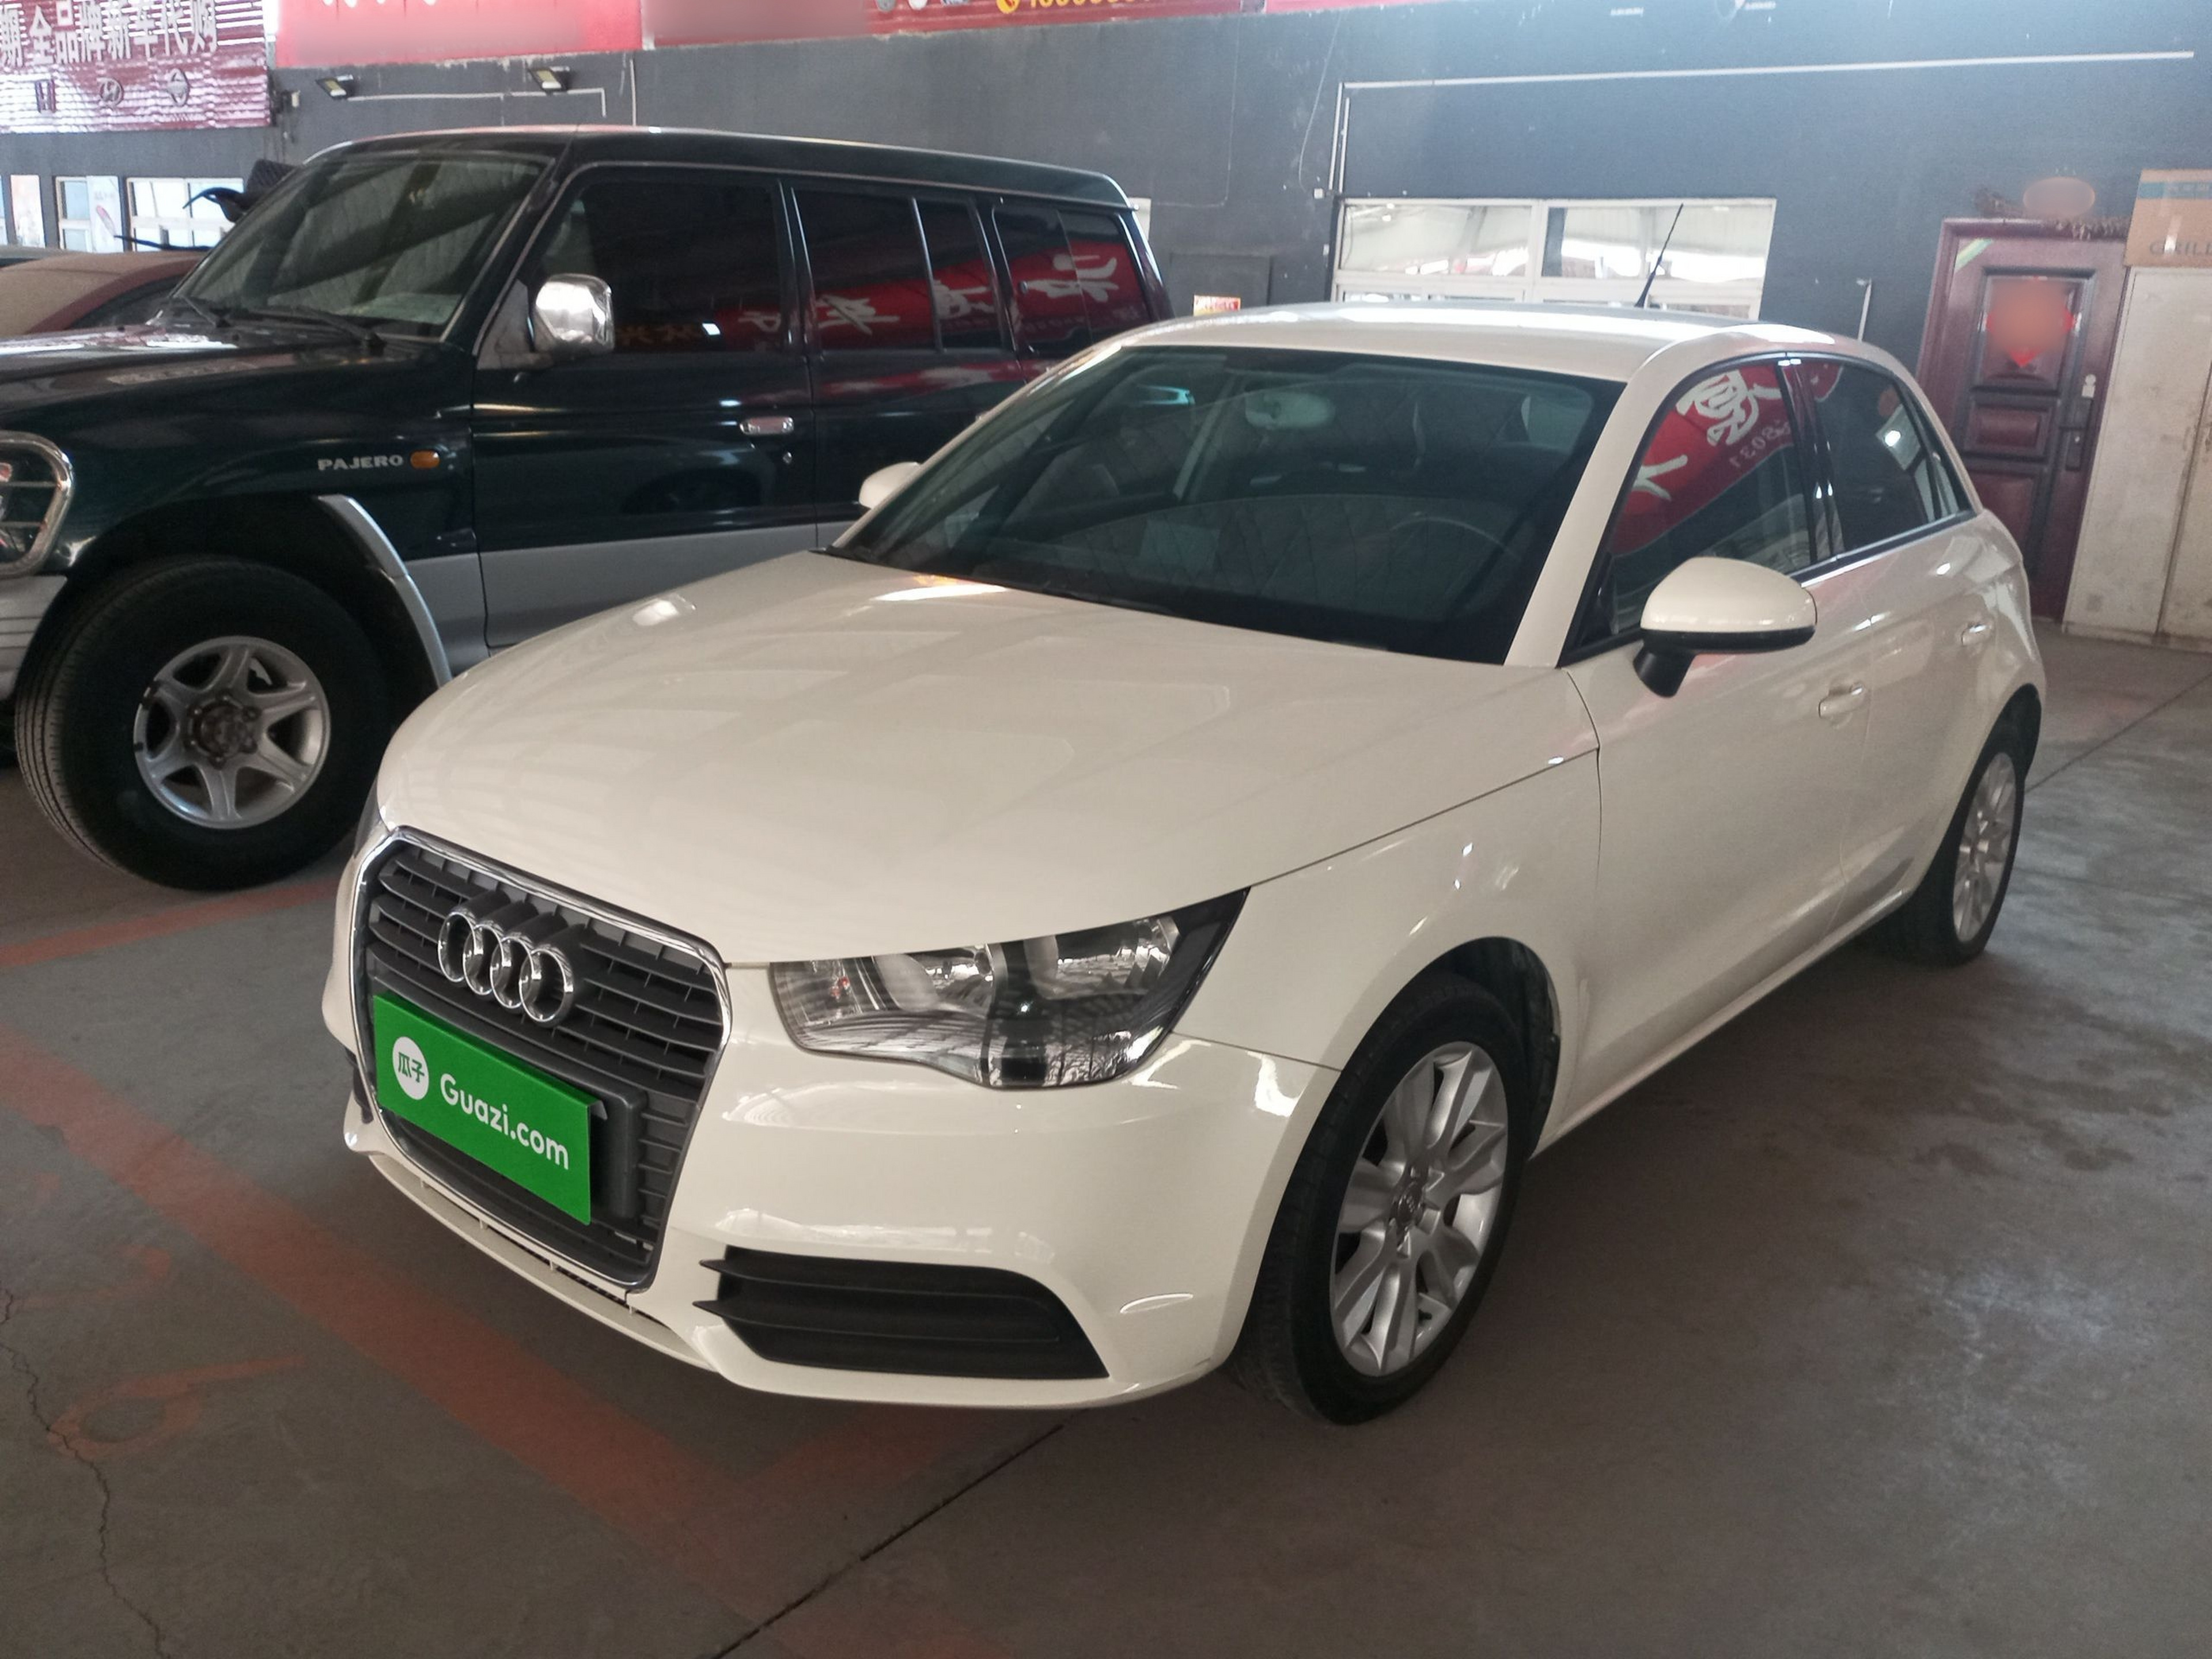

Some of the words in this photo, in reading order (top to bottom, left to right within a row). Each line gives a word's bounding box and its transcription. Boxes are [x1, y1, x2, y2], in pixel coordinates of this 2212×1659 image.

[317, 455, 403, 471] PAJERO
[398, 1051, 425, 1084] 瓜子
[440, 1073, 569, 1171] Guazi.com
